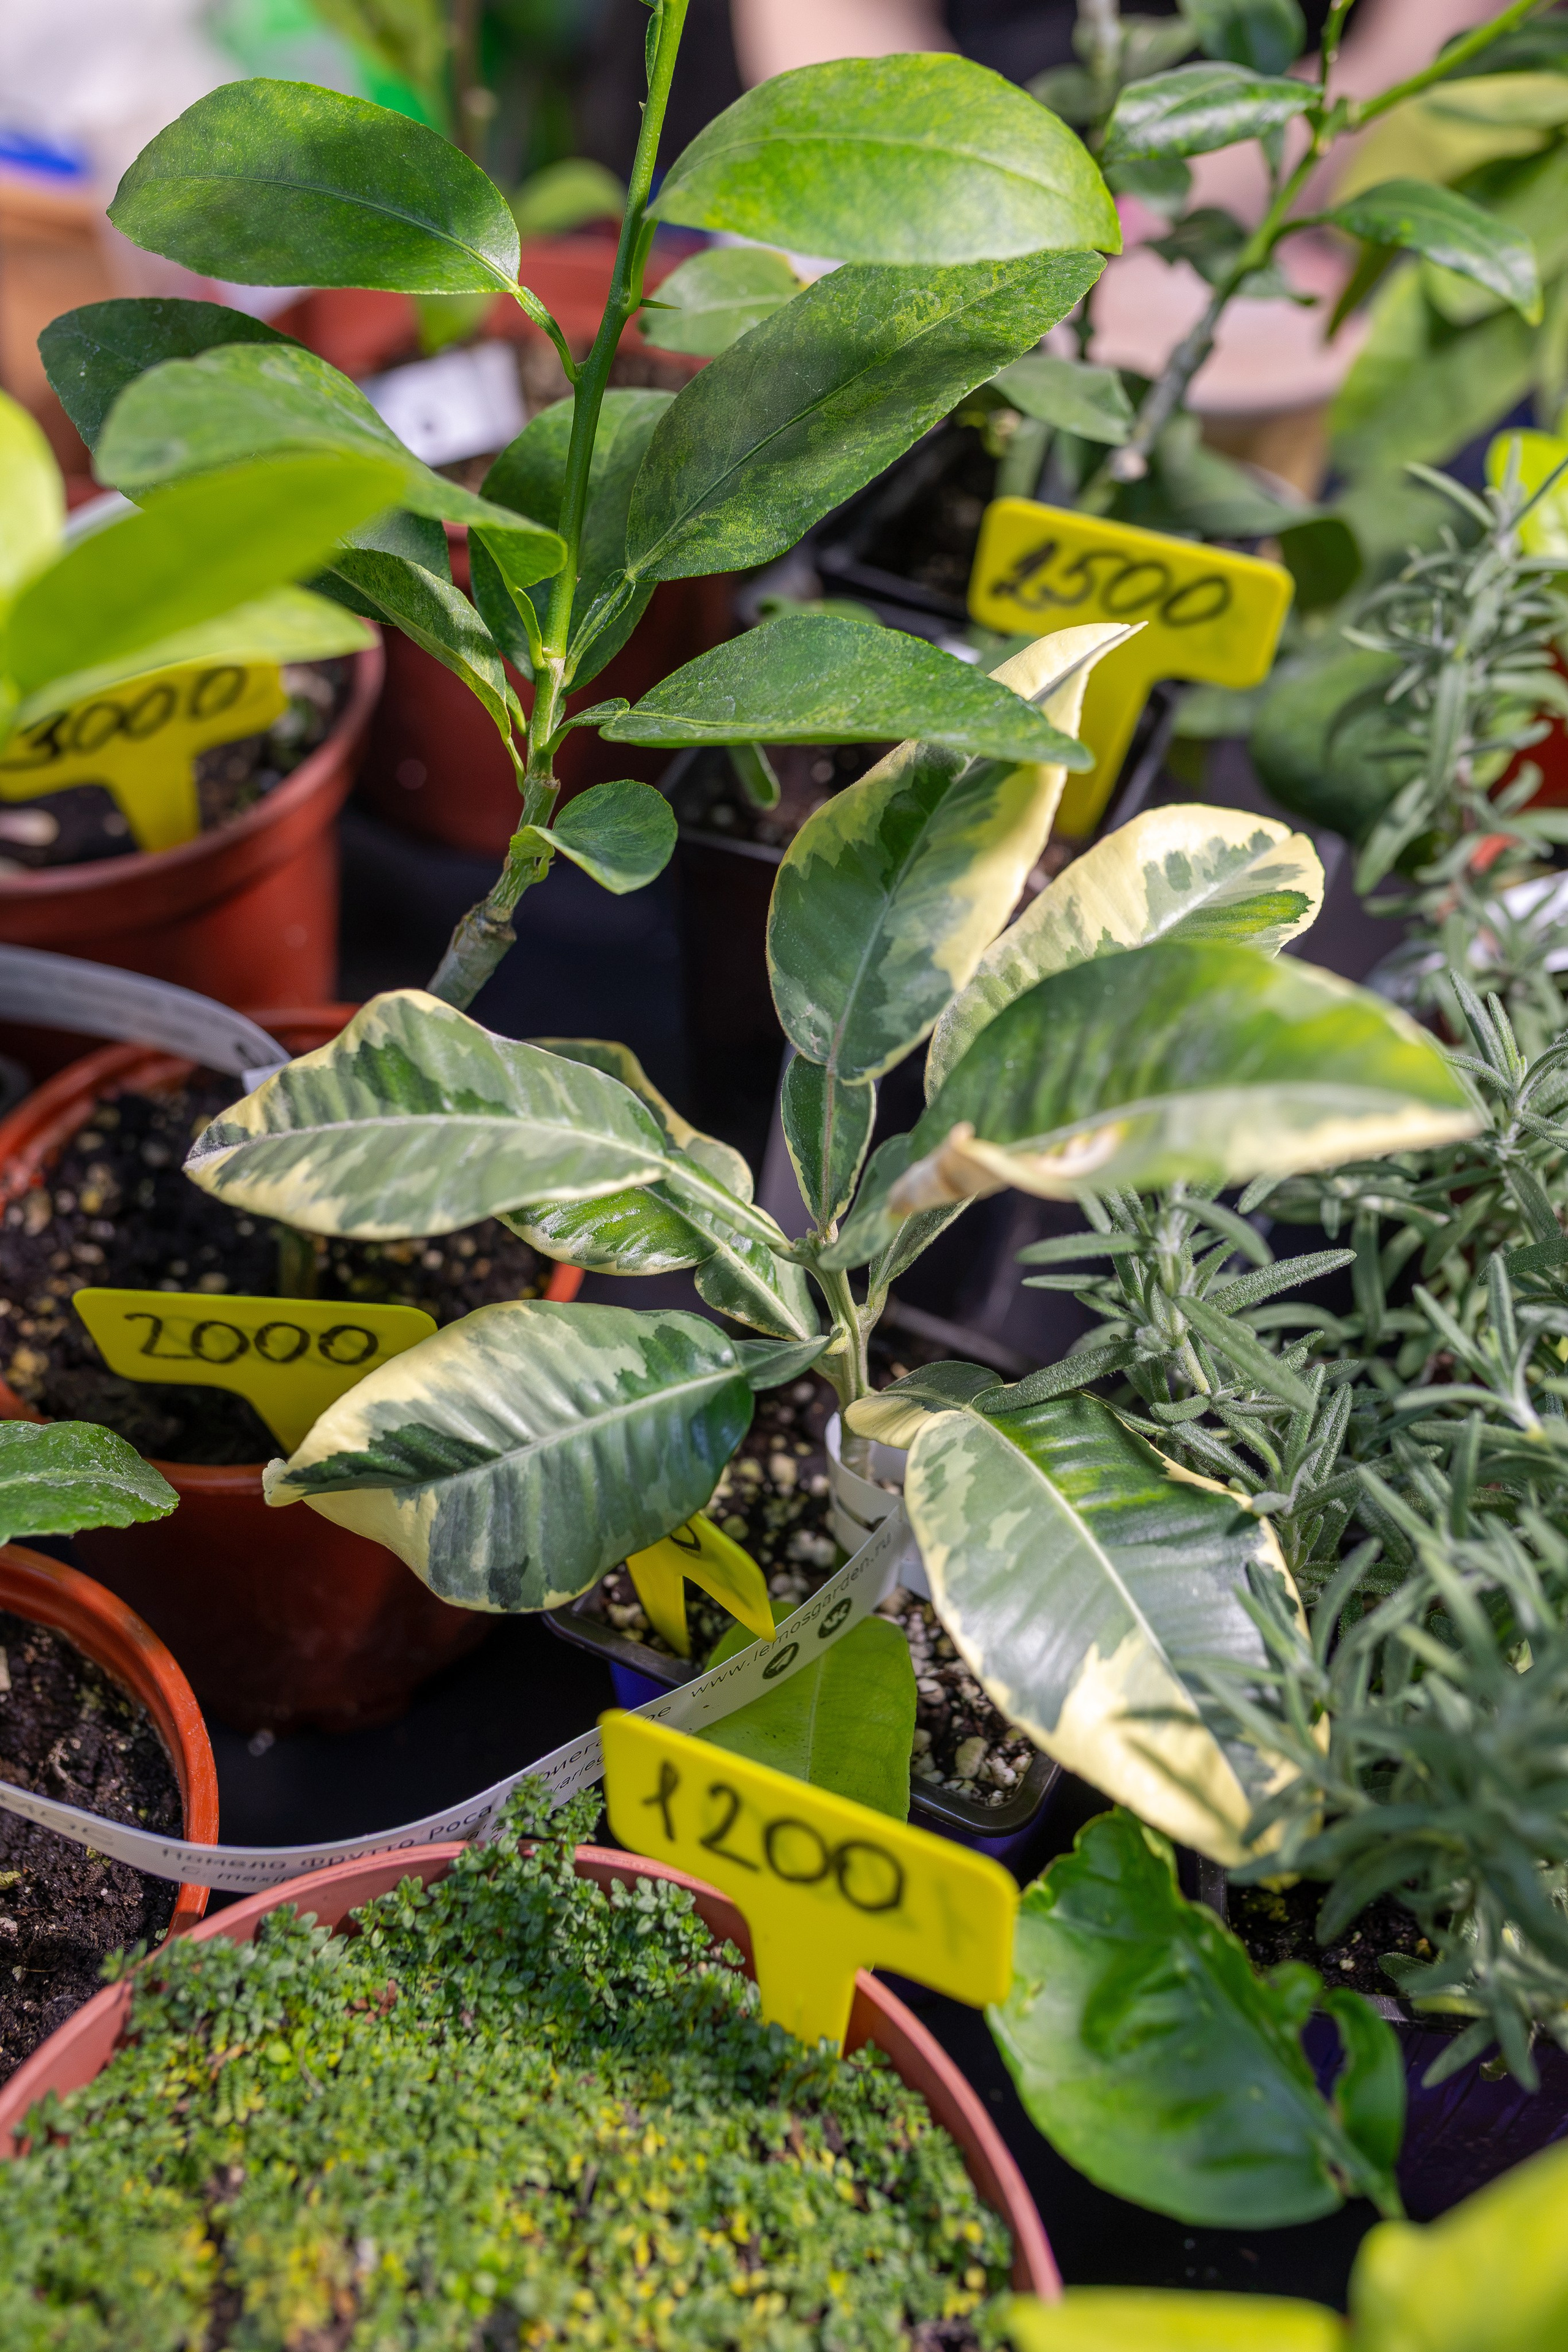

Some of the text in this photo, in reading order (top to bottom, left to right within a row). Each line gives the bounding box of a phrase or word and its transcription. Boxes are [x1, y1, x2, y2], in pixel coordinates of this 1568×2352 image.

[0, 665, 249, 772] 3000
[124, 1312, 380, 1366] 2000
[691, 1532, 892, 1698] www.lemosgarden.ru
[642, 1757, 905, 1914] 1200
